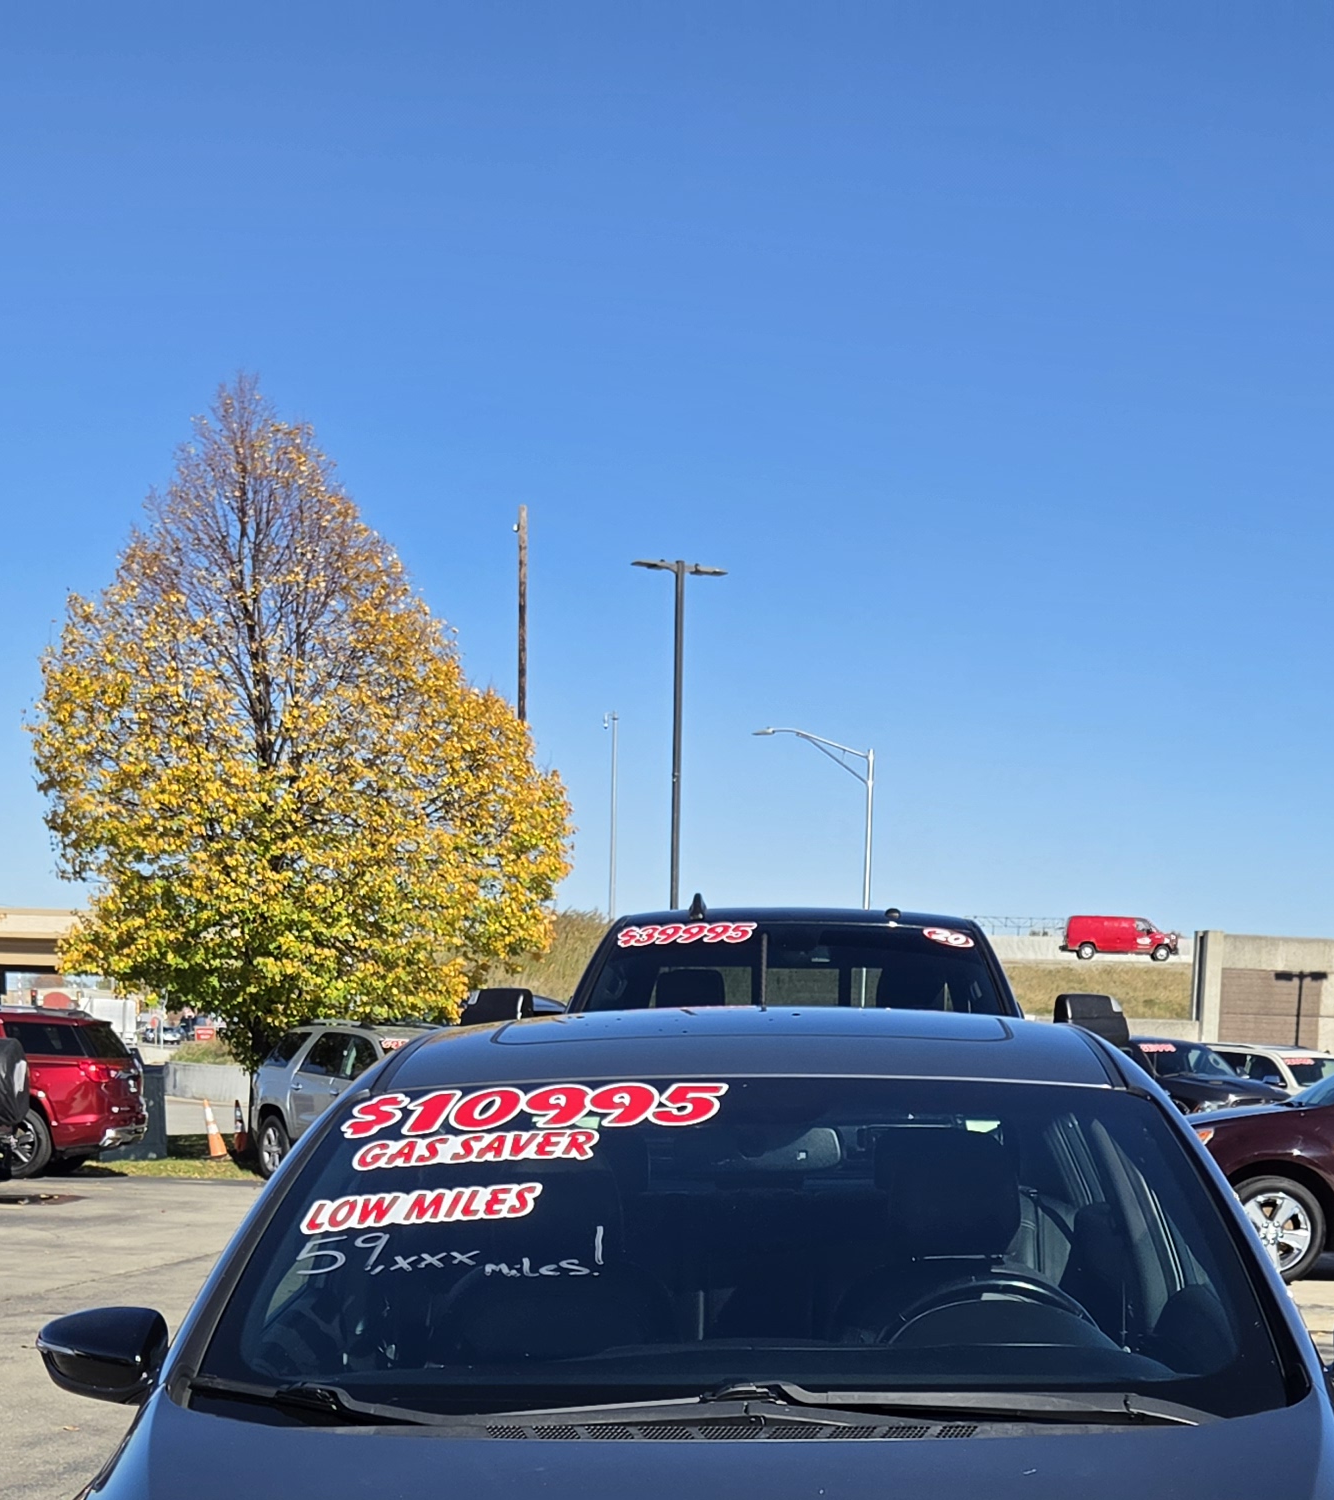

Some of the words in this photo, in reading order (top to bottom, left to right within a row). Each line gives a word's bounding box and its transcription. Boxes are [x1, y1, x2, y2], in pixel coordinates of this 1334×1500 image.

[618, 922, 757, 947] $39995
[341, 1083, 728, 1138] $10995
[354, 1137, 443, 1169] GAS
[457, 1132, 598, 1160] SAVER
[303, 1195, 400, 1233] LOW
[402, 1183, 541, 1221] MILES
